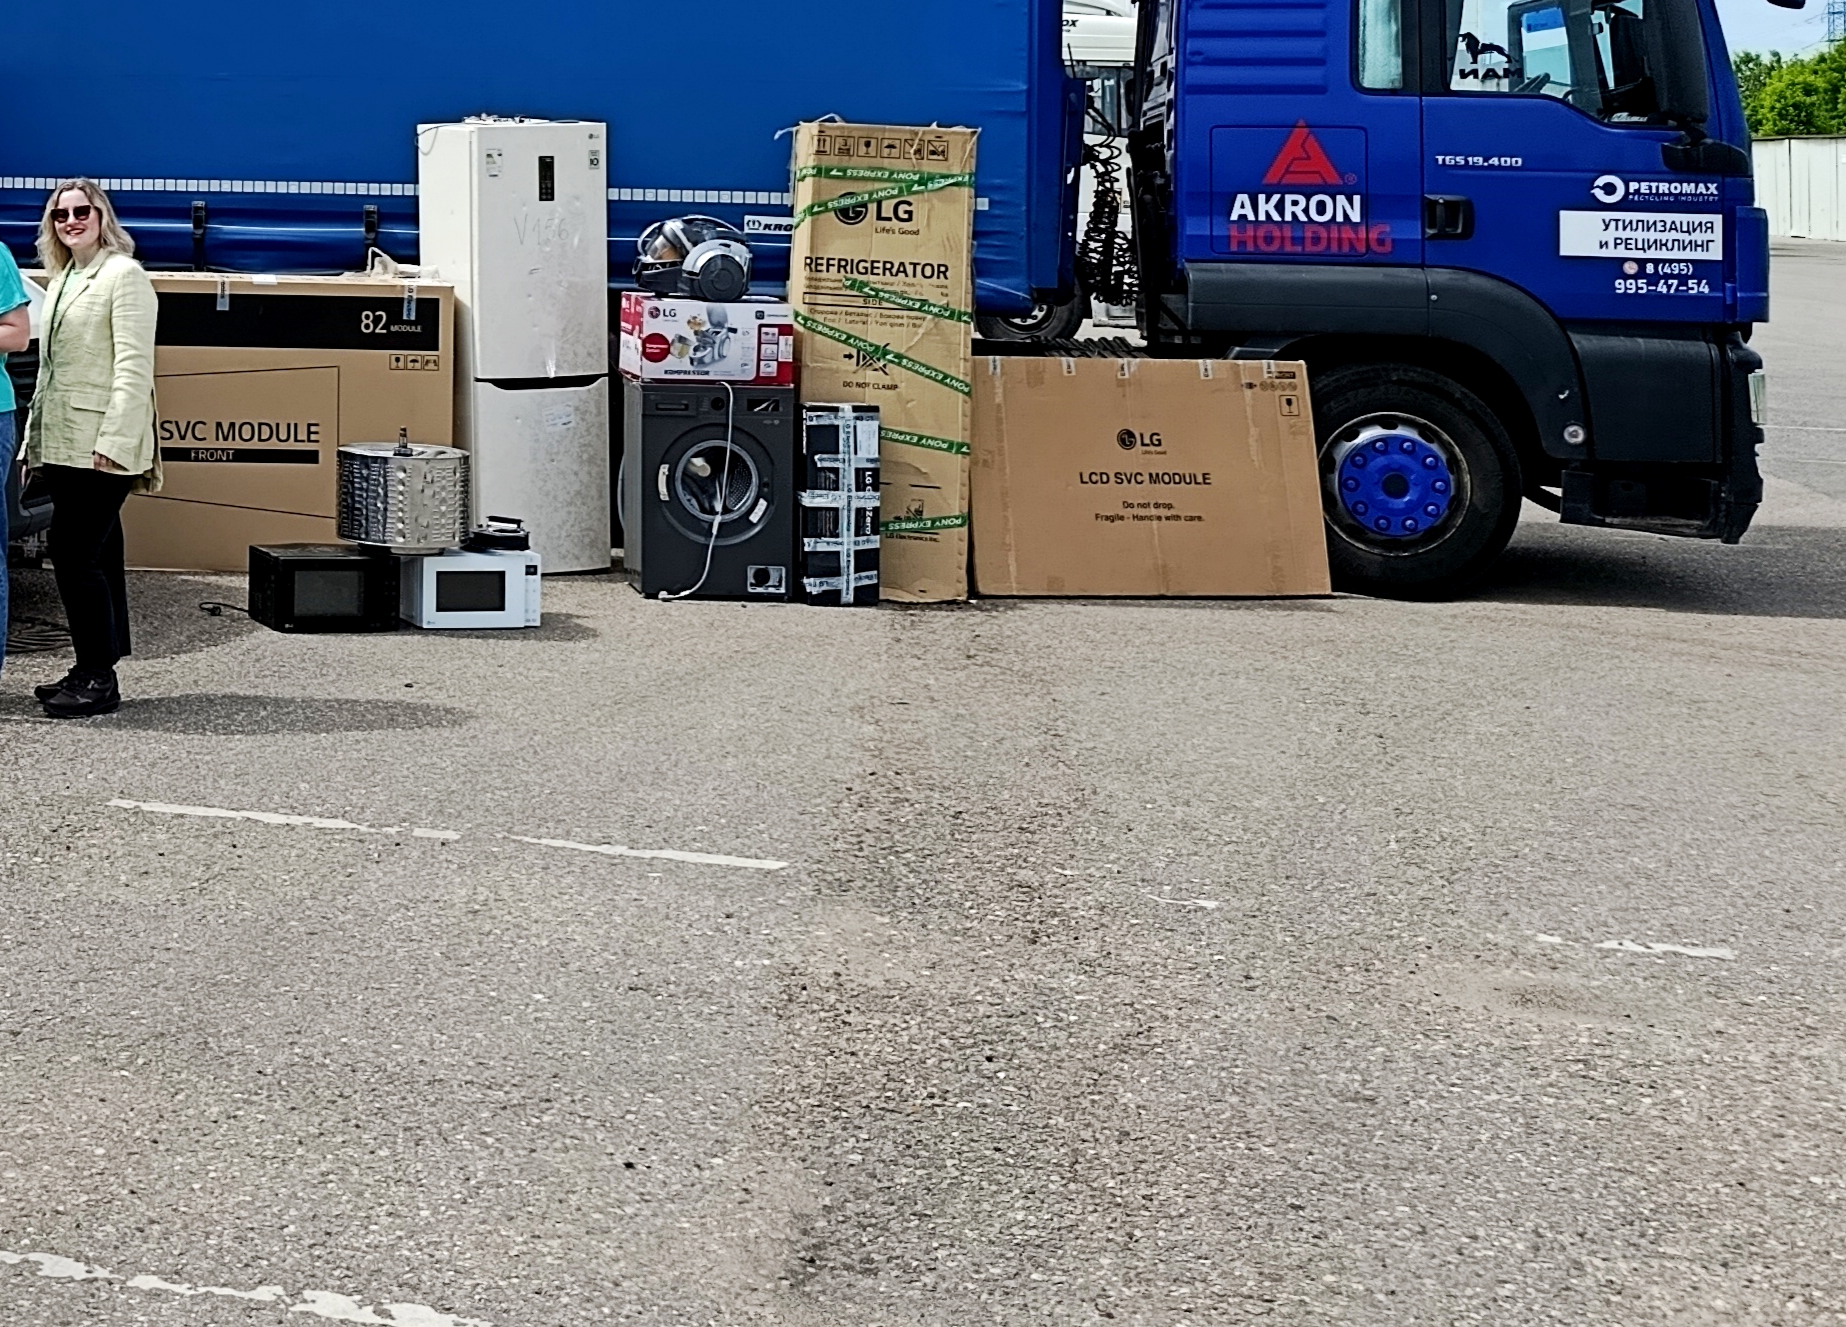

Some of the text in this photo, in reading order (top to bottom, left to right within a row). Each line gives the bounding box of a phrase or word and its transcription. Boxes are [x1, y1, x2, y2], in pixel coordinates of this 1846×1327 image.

[1435, 155, 1522, 167] TGS 19.400
[846, 169, 920, 181] PONY EXPRESS
[1629, 181, 1719, 195] PETROMAX
[827, 187, 899, 209] PONY EXPRESS
[875, 199, 914, 223] LG
[1230, 193, 1361, 223] AKRON
[763, 223, 794, 231] KRO
[875, 227, 920, 236] Life's Good
[1602, 218, 1714, 236] УТИЛИЗАЦИЯ
[1229, 223, 1393, 254] HOLDING
[1599, 238, 1714, 253] и РЕЦИКЛИНГ
[805, 256, 949, 280] REFRIGERATOR
[1645, 262, 1693, 275] 8 (495)
[1615, 279, 1710, 294] 995-47-54
[662, 308, 677, 318] LG
[921, 304, 951, 317] PONY
[360, 311, 422, 334] 82 MODULE
[806, 320, 875, 352] PONY EXPRESS
[902, 359, 970, 393] PONY EXPRESS
[843, 380, 898, 391] DO NOT CLAMP
[160, 420, 320, 444] SVC MODULE
[880, 430, 950, 449] PONY EXPRES
[1140, 432, 1162, 447] LG
[191, 449, 235, 461] FRONT
[865, 471, 873, 484] LG
[1080, 471, 1212, 485] LCD SVC MODULE
[1122, 500, 1175, 512] Do not drop.
[888, 517, 962, 530] PONY EXPRESS
[1095, 512, 1125, 523] Fragile
[1132, 512, 1163, 522] Handle
[1164, 513, 1180, 522] with
[1182, 514, 1205, 522] care.
